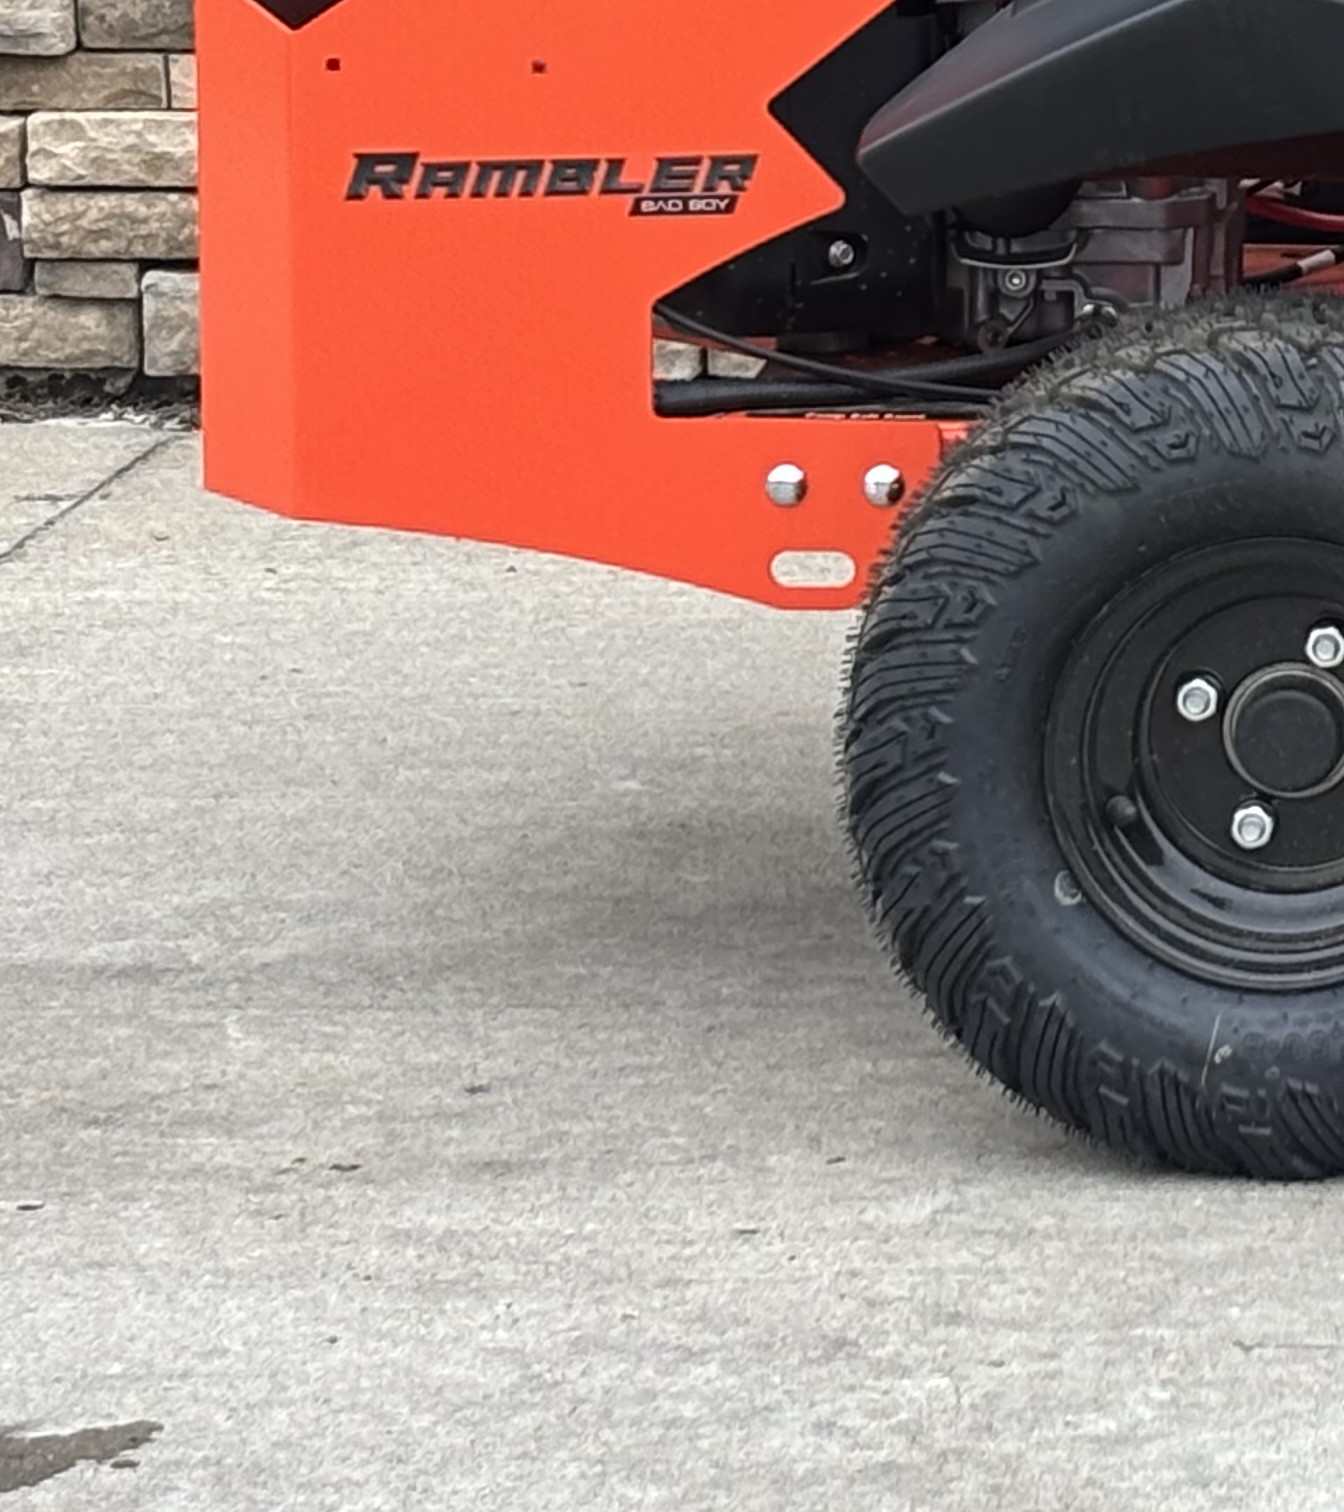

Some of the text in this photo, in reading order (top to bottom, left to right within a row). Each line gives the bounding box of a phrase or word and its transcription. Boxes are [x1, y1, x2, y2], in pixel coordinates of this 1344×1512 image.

[343, 151, 759, 201] RAMBLER
[640, 197, 731, 213] BAD BOY
